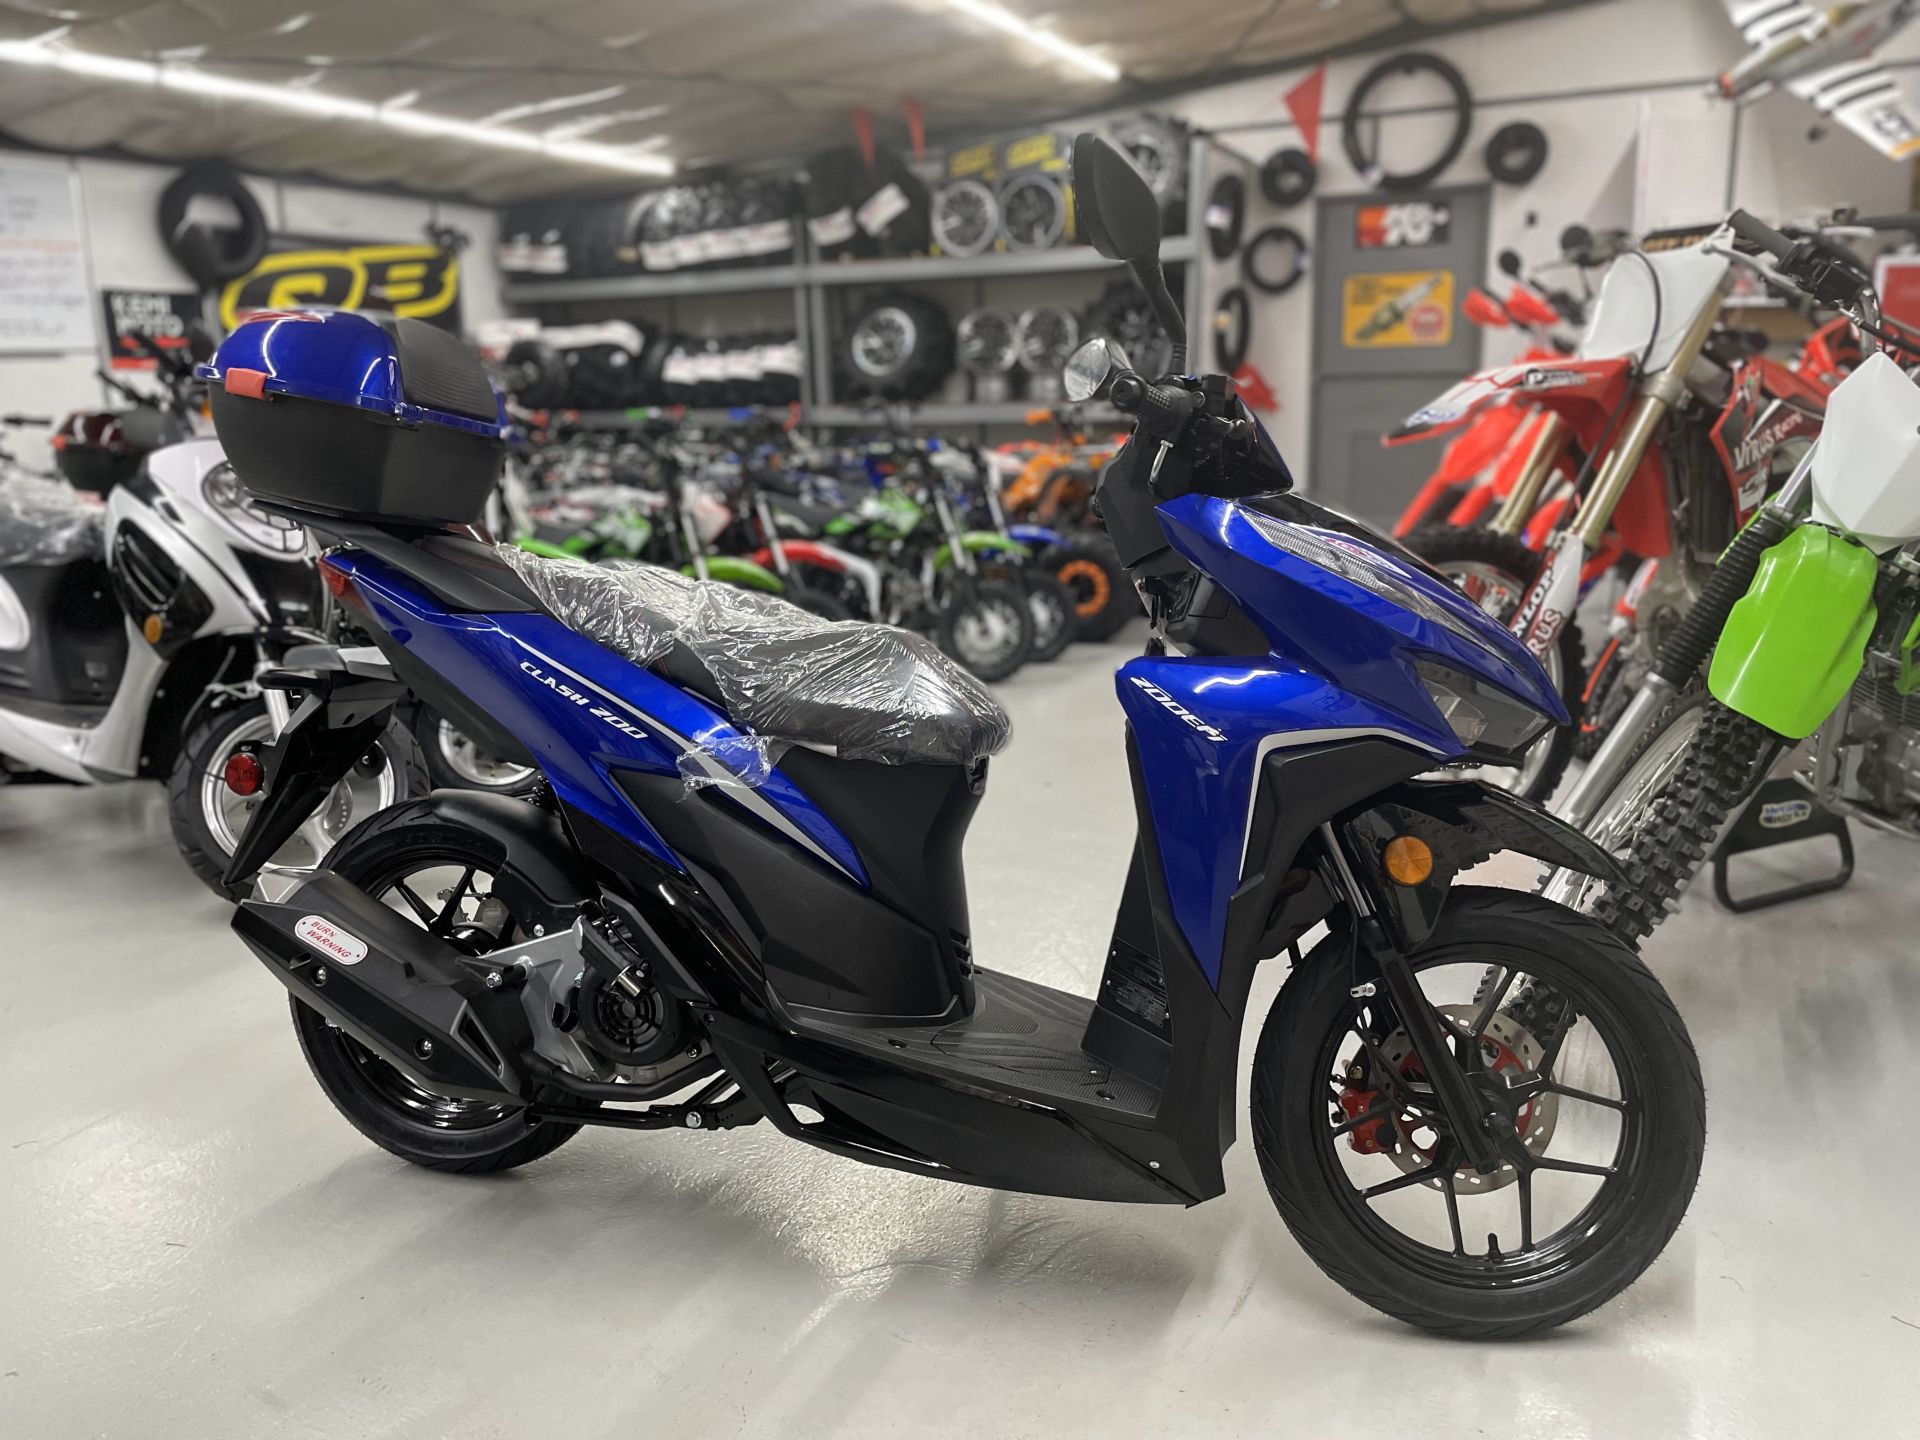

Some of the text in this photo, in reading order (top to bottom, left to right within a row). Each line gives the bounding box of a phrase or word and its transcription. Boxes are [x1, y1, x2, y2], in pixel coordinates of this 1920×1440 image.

[1511, 567, 1554, 638] NLOP
[1526, 608, 1563, 656] RUS
[520, 661, 648, 739] CLASH 200
[306, 929, 352, 958] WARNING
[311, 921, 337, 938] BURN
